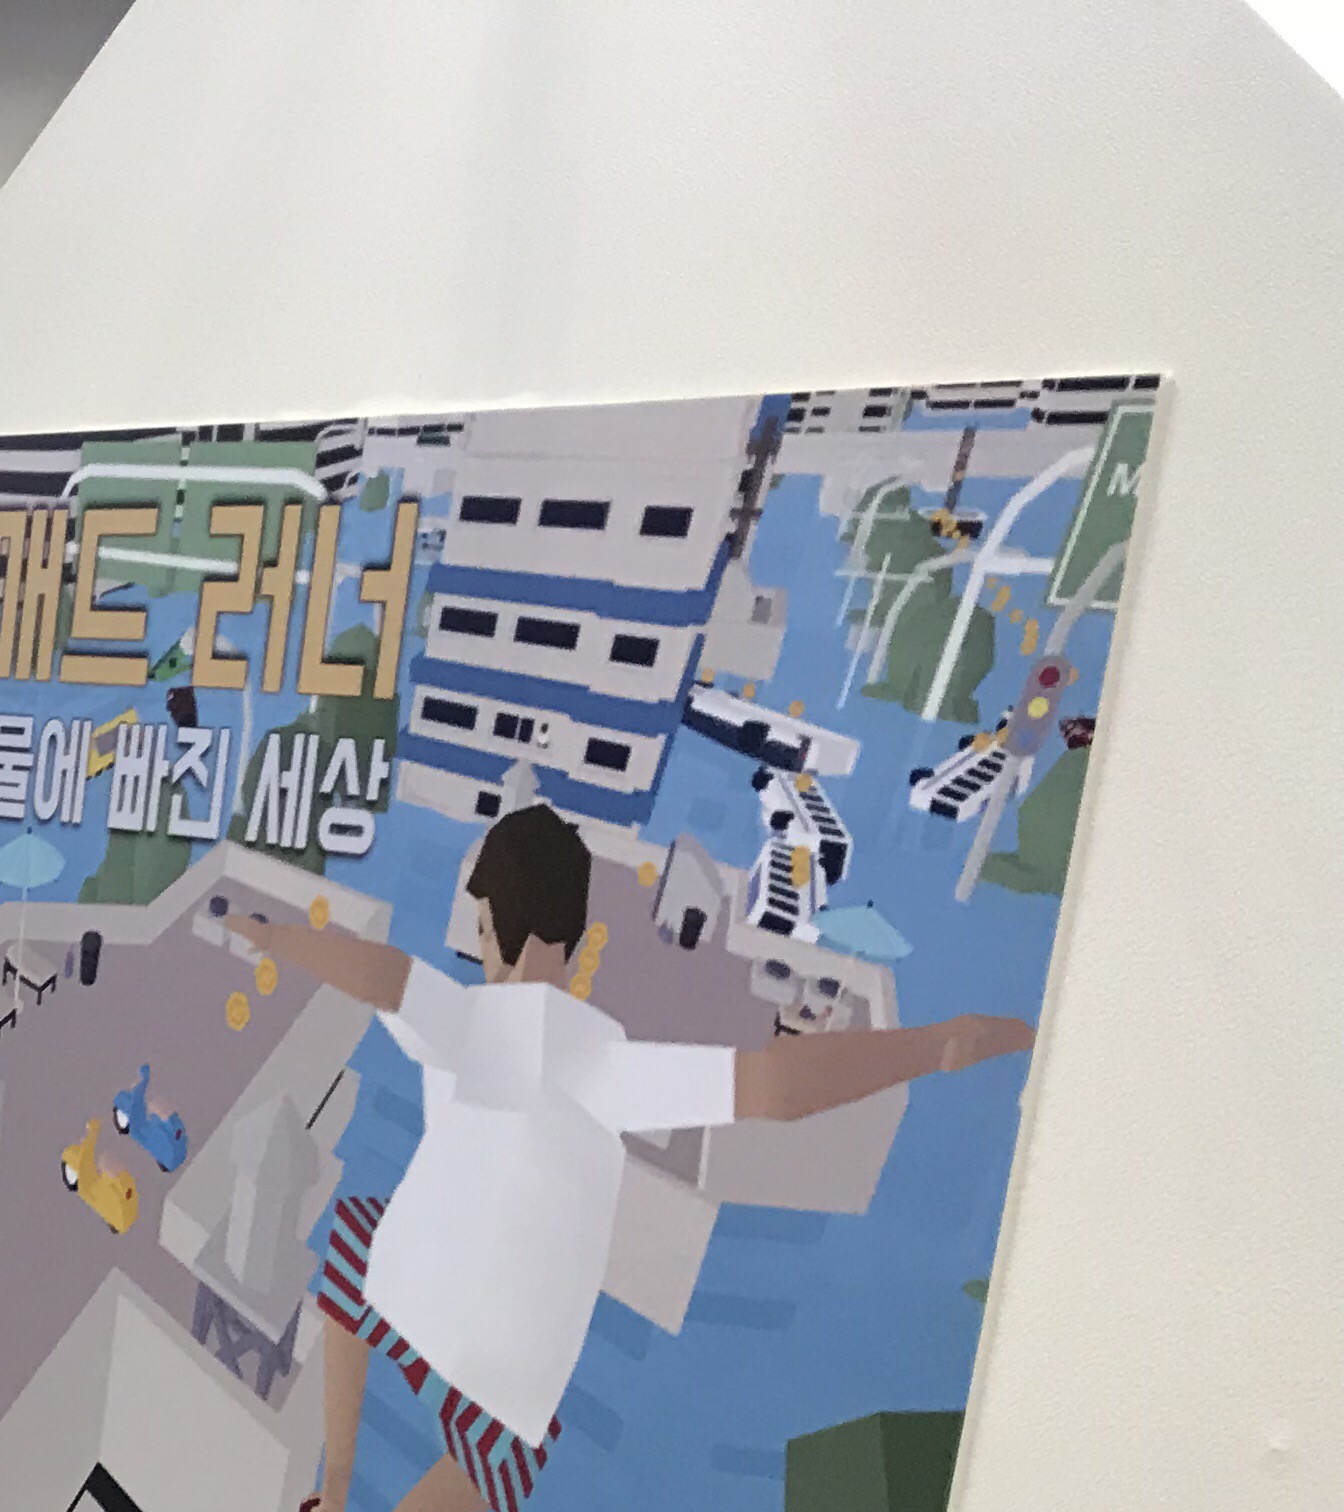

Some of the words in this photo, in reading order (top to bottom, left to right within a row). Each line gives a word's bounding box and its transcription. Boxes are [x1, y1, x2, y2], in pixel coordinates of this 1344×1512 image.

[191, 500, 420, 700] 러너
[107, 722, 231, 840] 빠진
[244, 731, 390, 856] 세상
